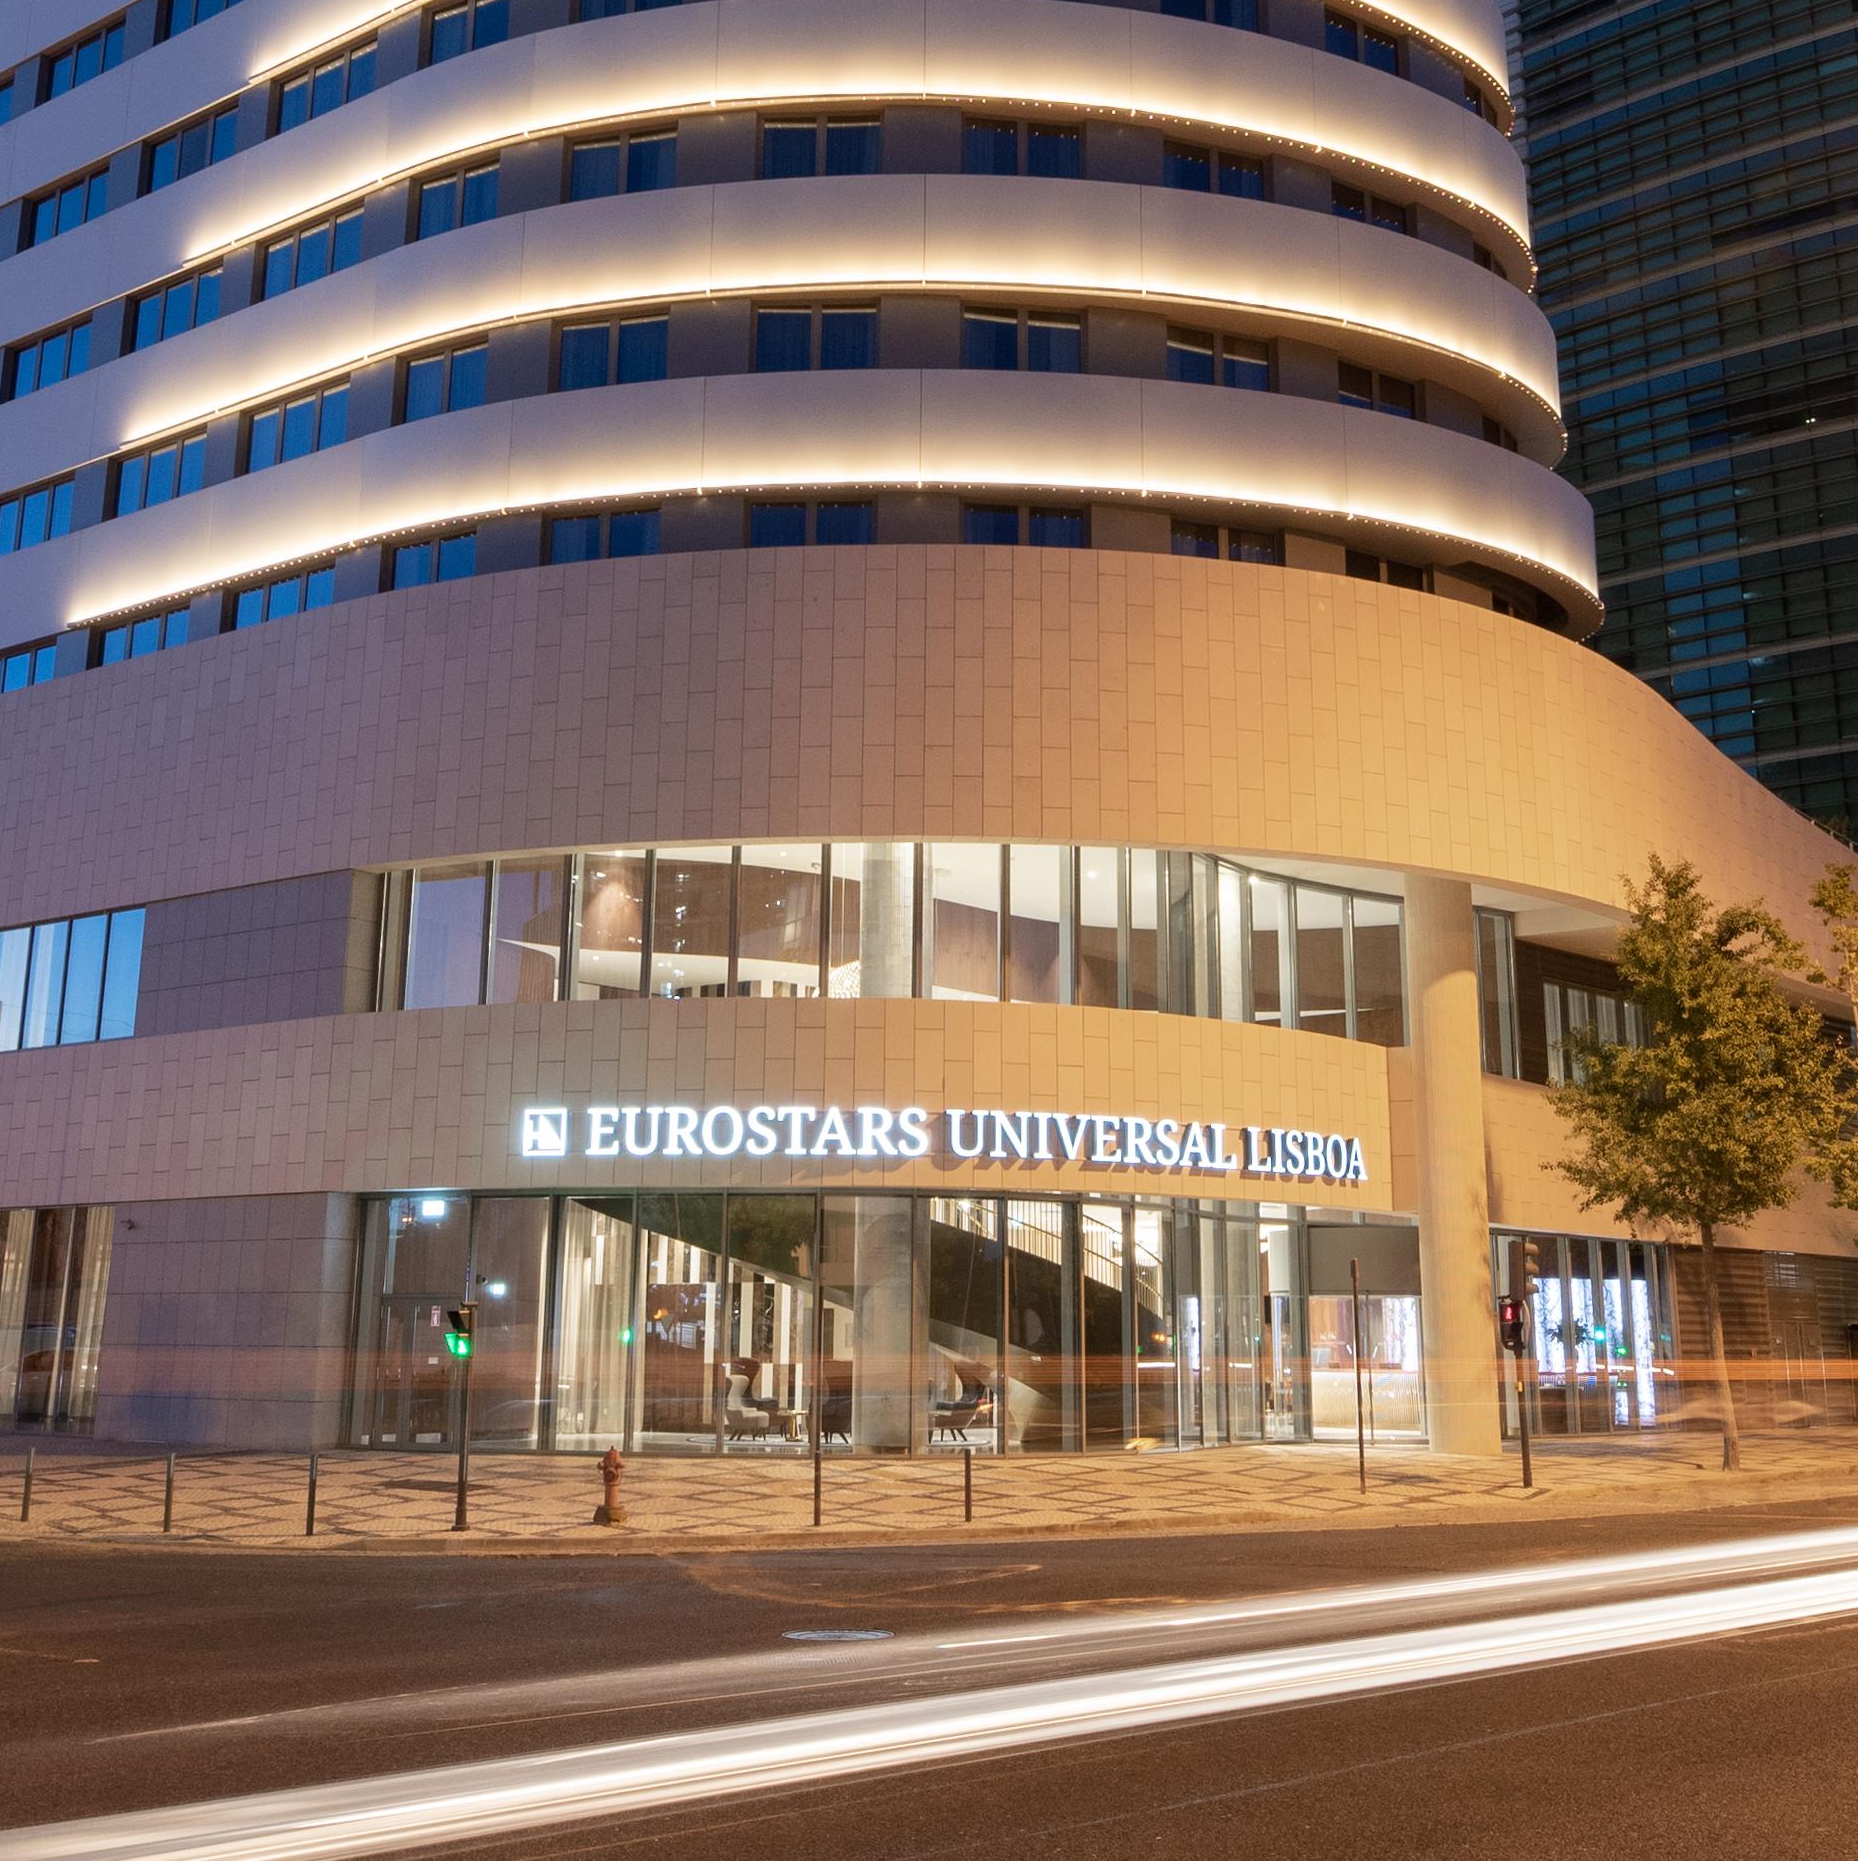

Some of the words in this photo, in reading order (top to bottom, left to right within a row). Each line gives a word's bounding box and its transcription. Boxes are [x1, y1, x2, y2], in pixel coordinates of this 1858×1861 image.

[585, 1105, 929, 1158] EUROSTARS
[945, 1109, 1238, 1170] UNIVERSAL
[1246, 1125, 1369, 1182] LISBOA
